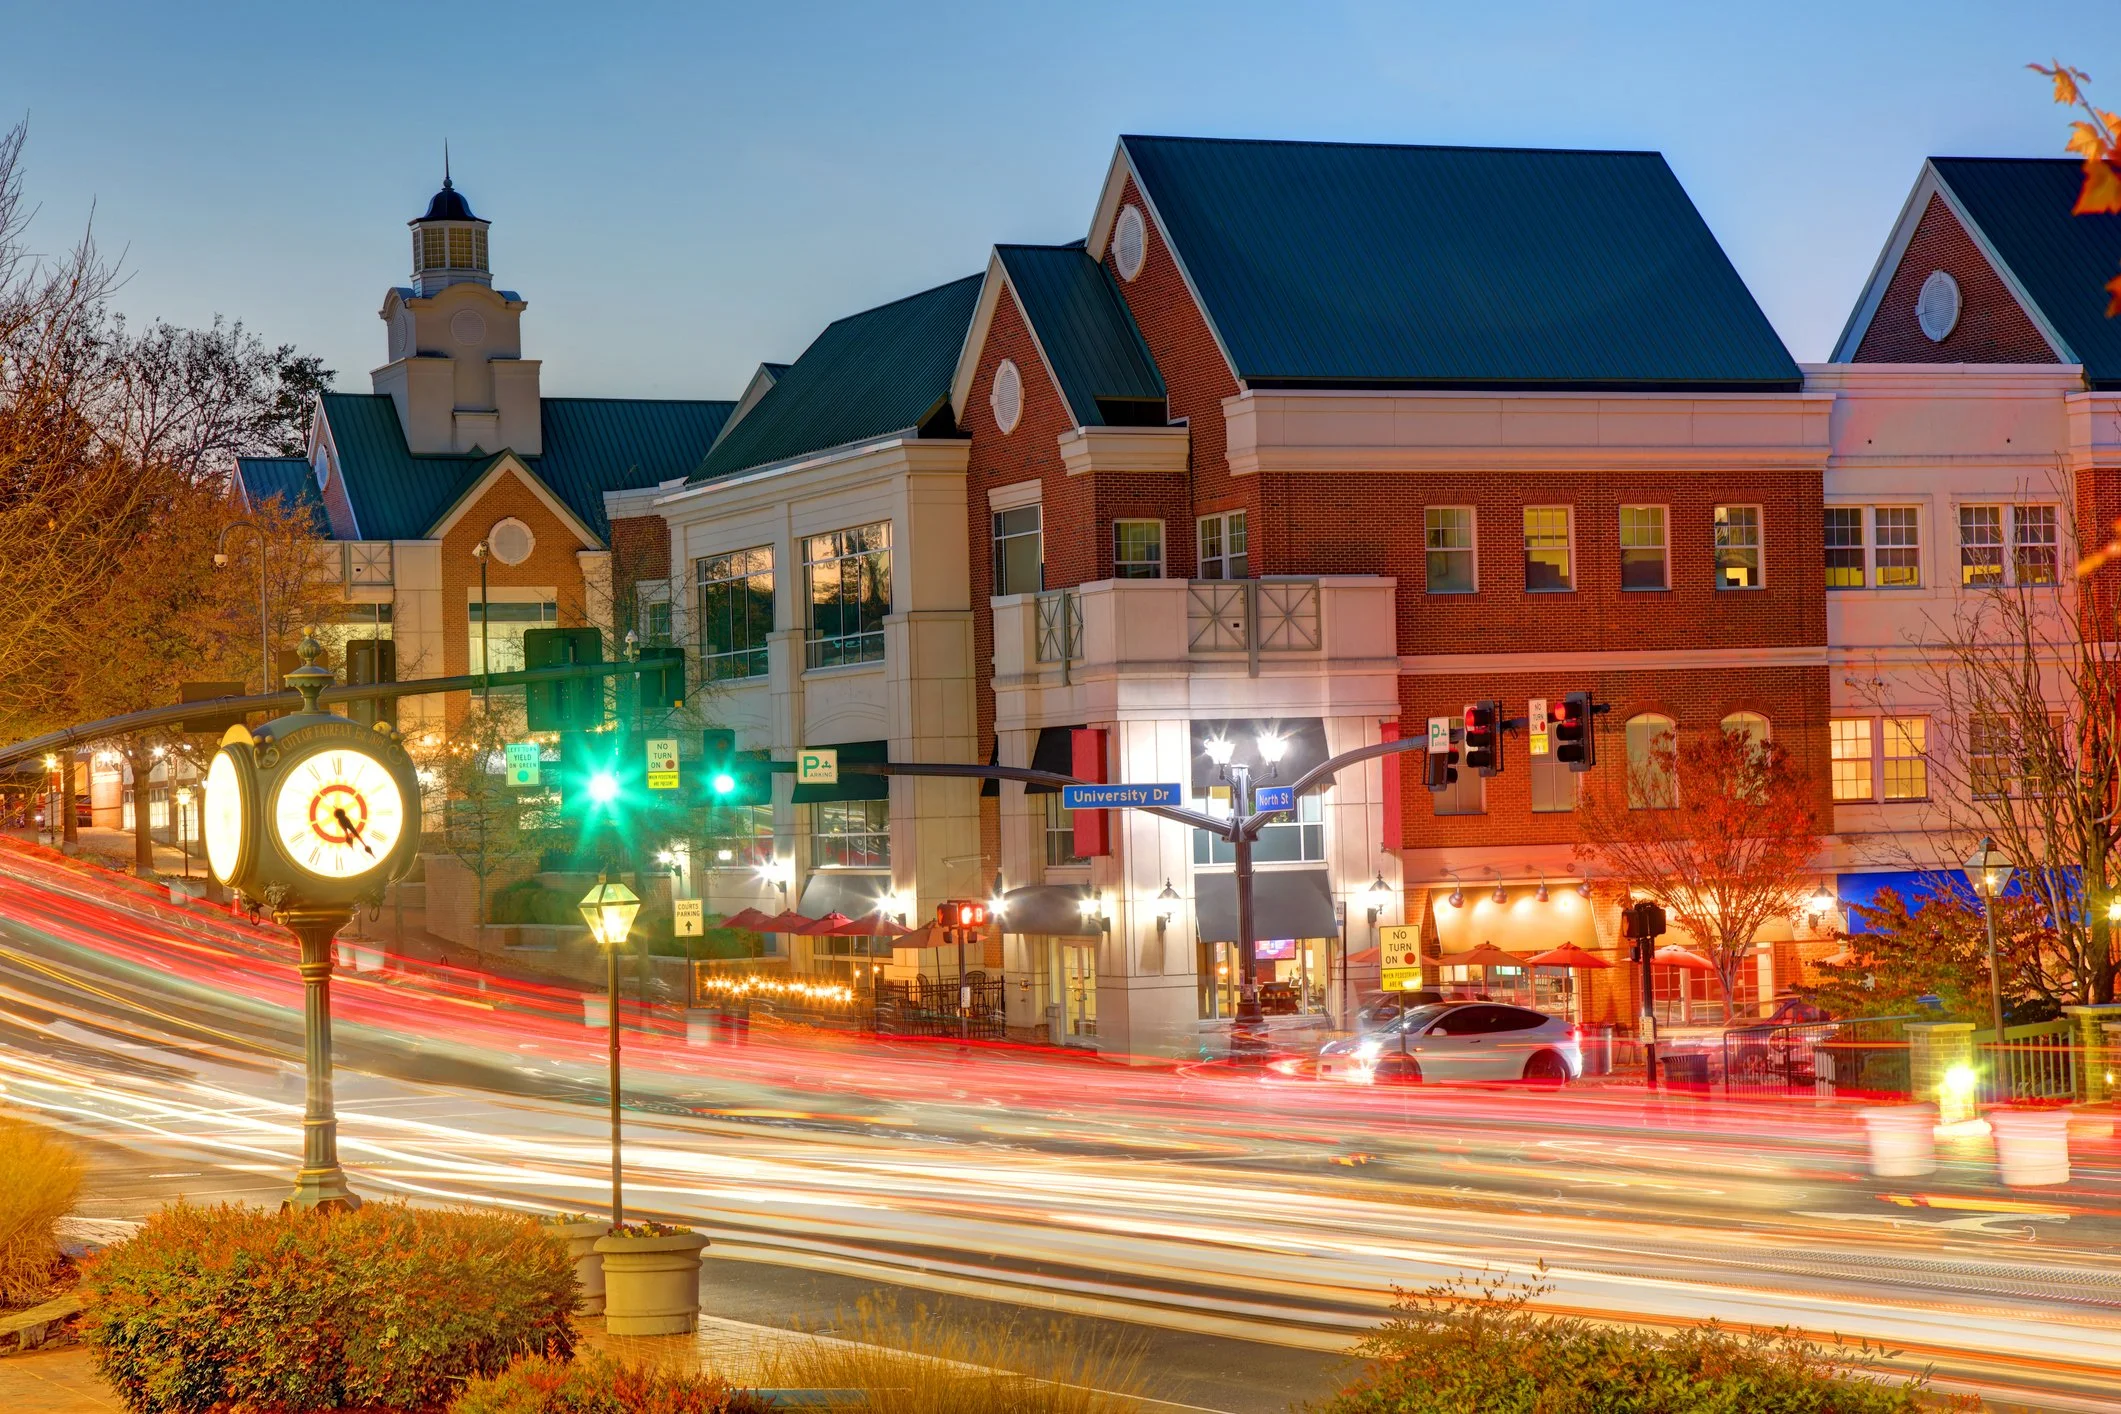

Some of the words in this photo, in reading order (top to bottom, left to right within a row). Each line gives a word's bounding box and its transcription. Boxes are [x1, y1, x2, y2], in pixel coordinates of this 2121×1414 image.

[281, 734, 301, 751] CITY
[301, 727, 313, 742] OF
[314, 723, 353, 738] FAIRFAX
[514, 753, 532, 761] YIELD
[654, 752, 672, 760] TURN
[1073, 789, 1148, 804] University
[1153, 788, 1170, 801] Dr
[1260, 793, 1279, 806] North
[1281, 792, 1289, 805] St
[1392, 931, 1406, 939] NO
[1388, 943, 1412, 951] TURN
[1386, 956, 1398, 964] ON
